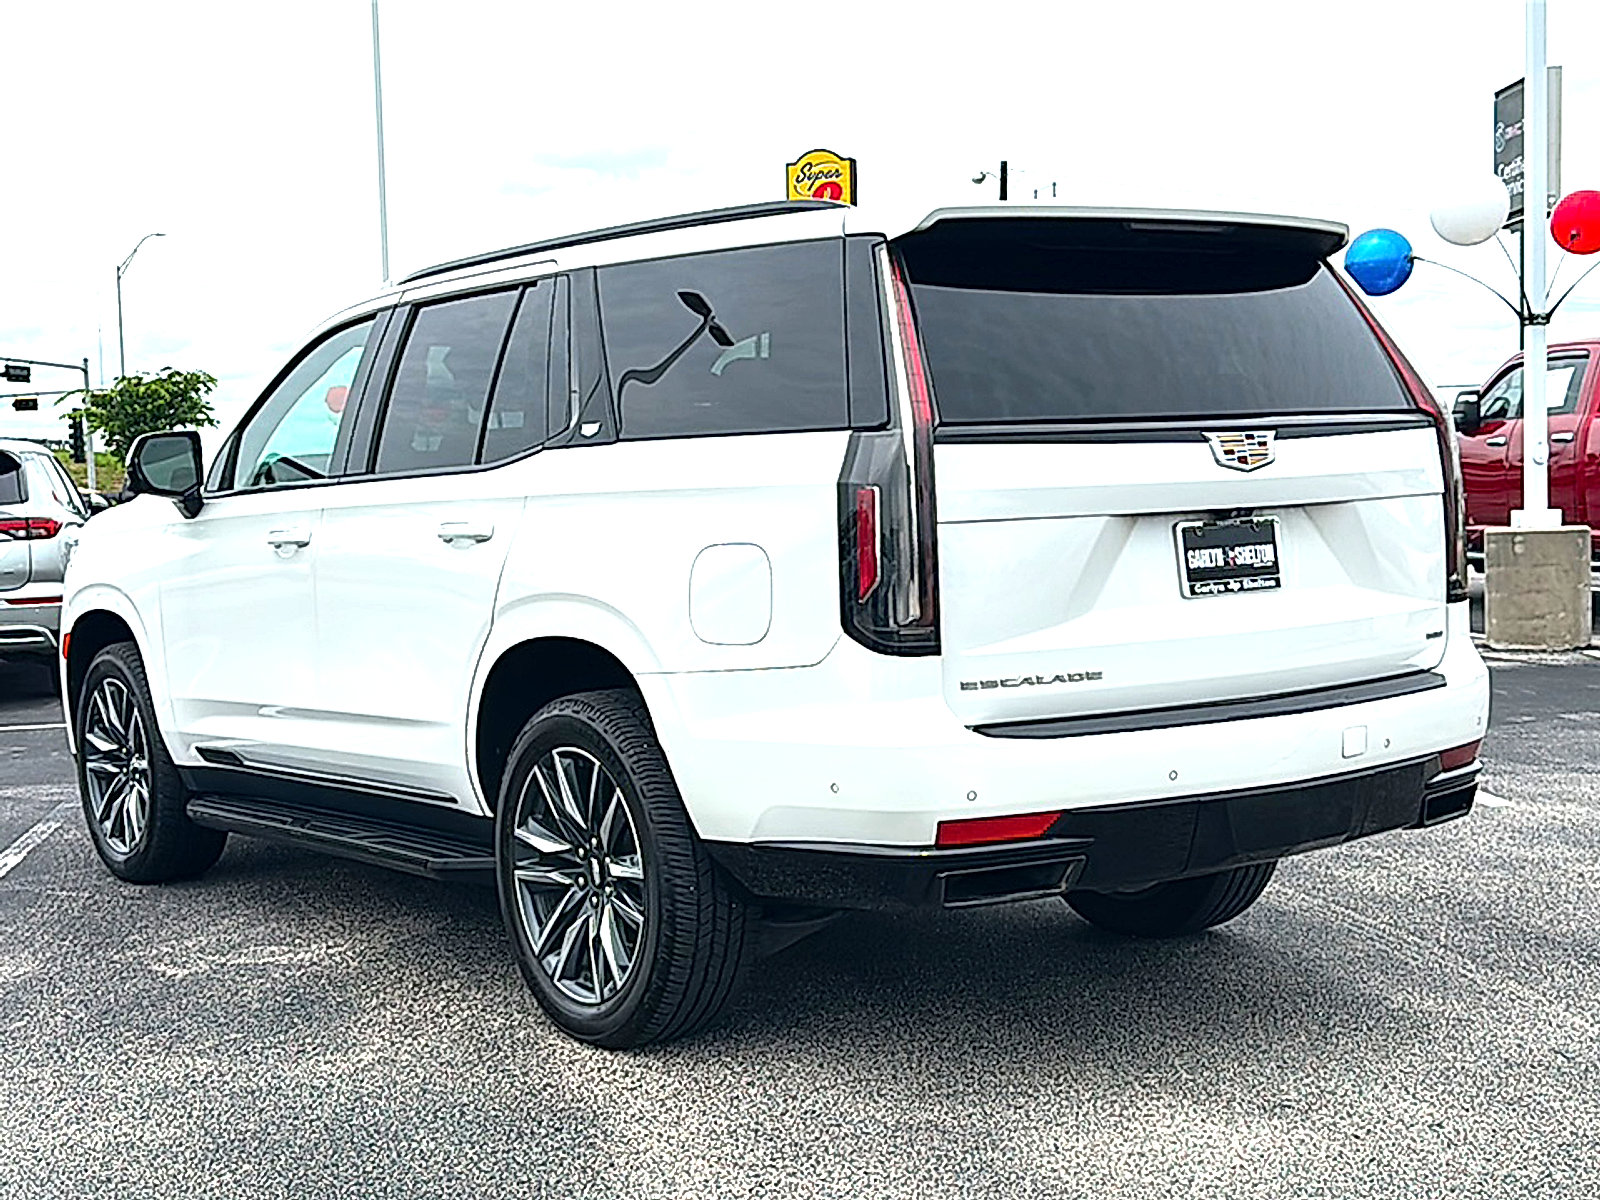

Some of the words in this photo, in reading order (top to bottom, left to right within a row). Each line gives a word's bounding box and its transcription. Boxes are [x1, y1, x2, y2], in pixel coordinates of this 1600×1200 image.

[796, 162, 842, 191] Super
[1187, 547, 1225, 569] GARLYN
[1235, 544, 1275, 565] SHELTON
[960, 671, 1103, 690] ESCALADE
